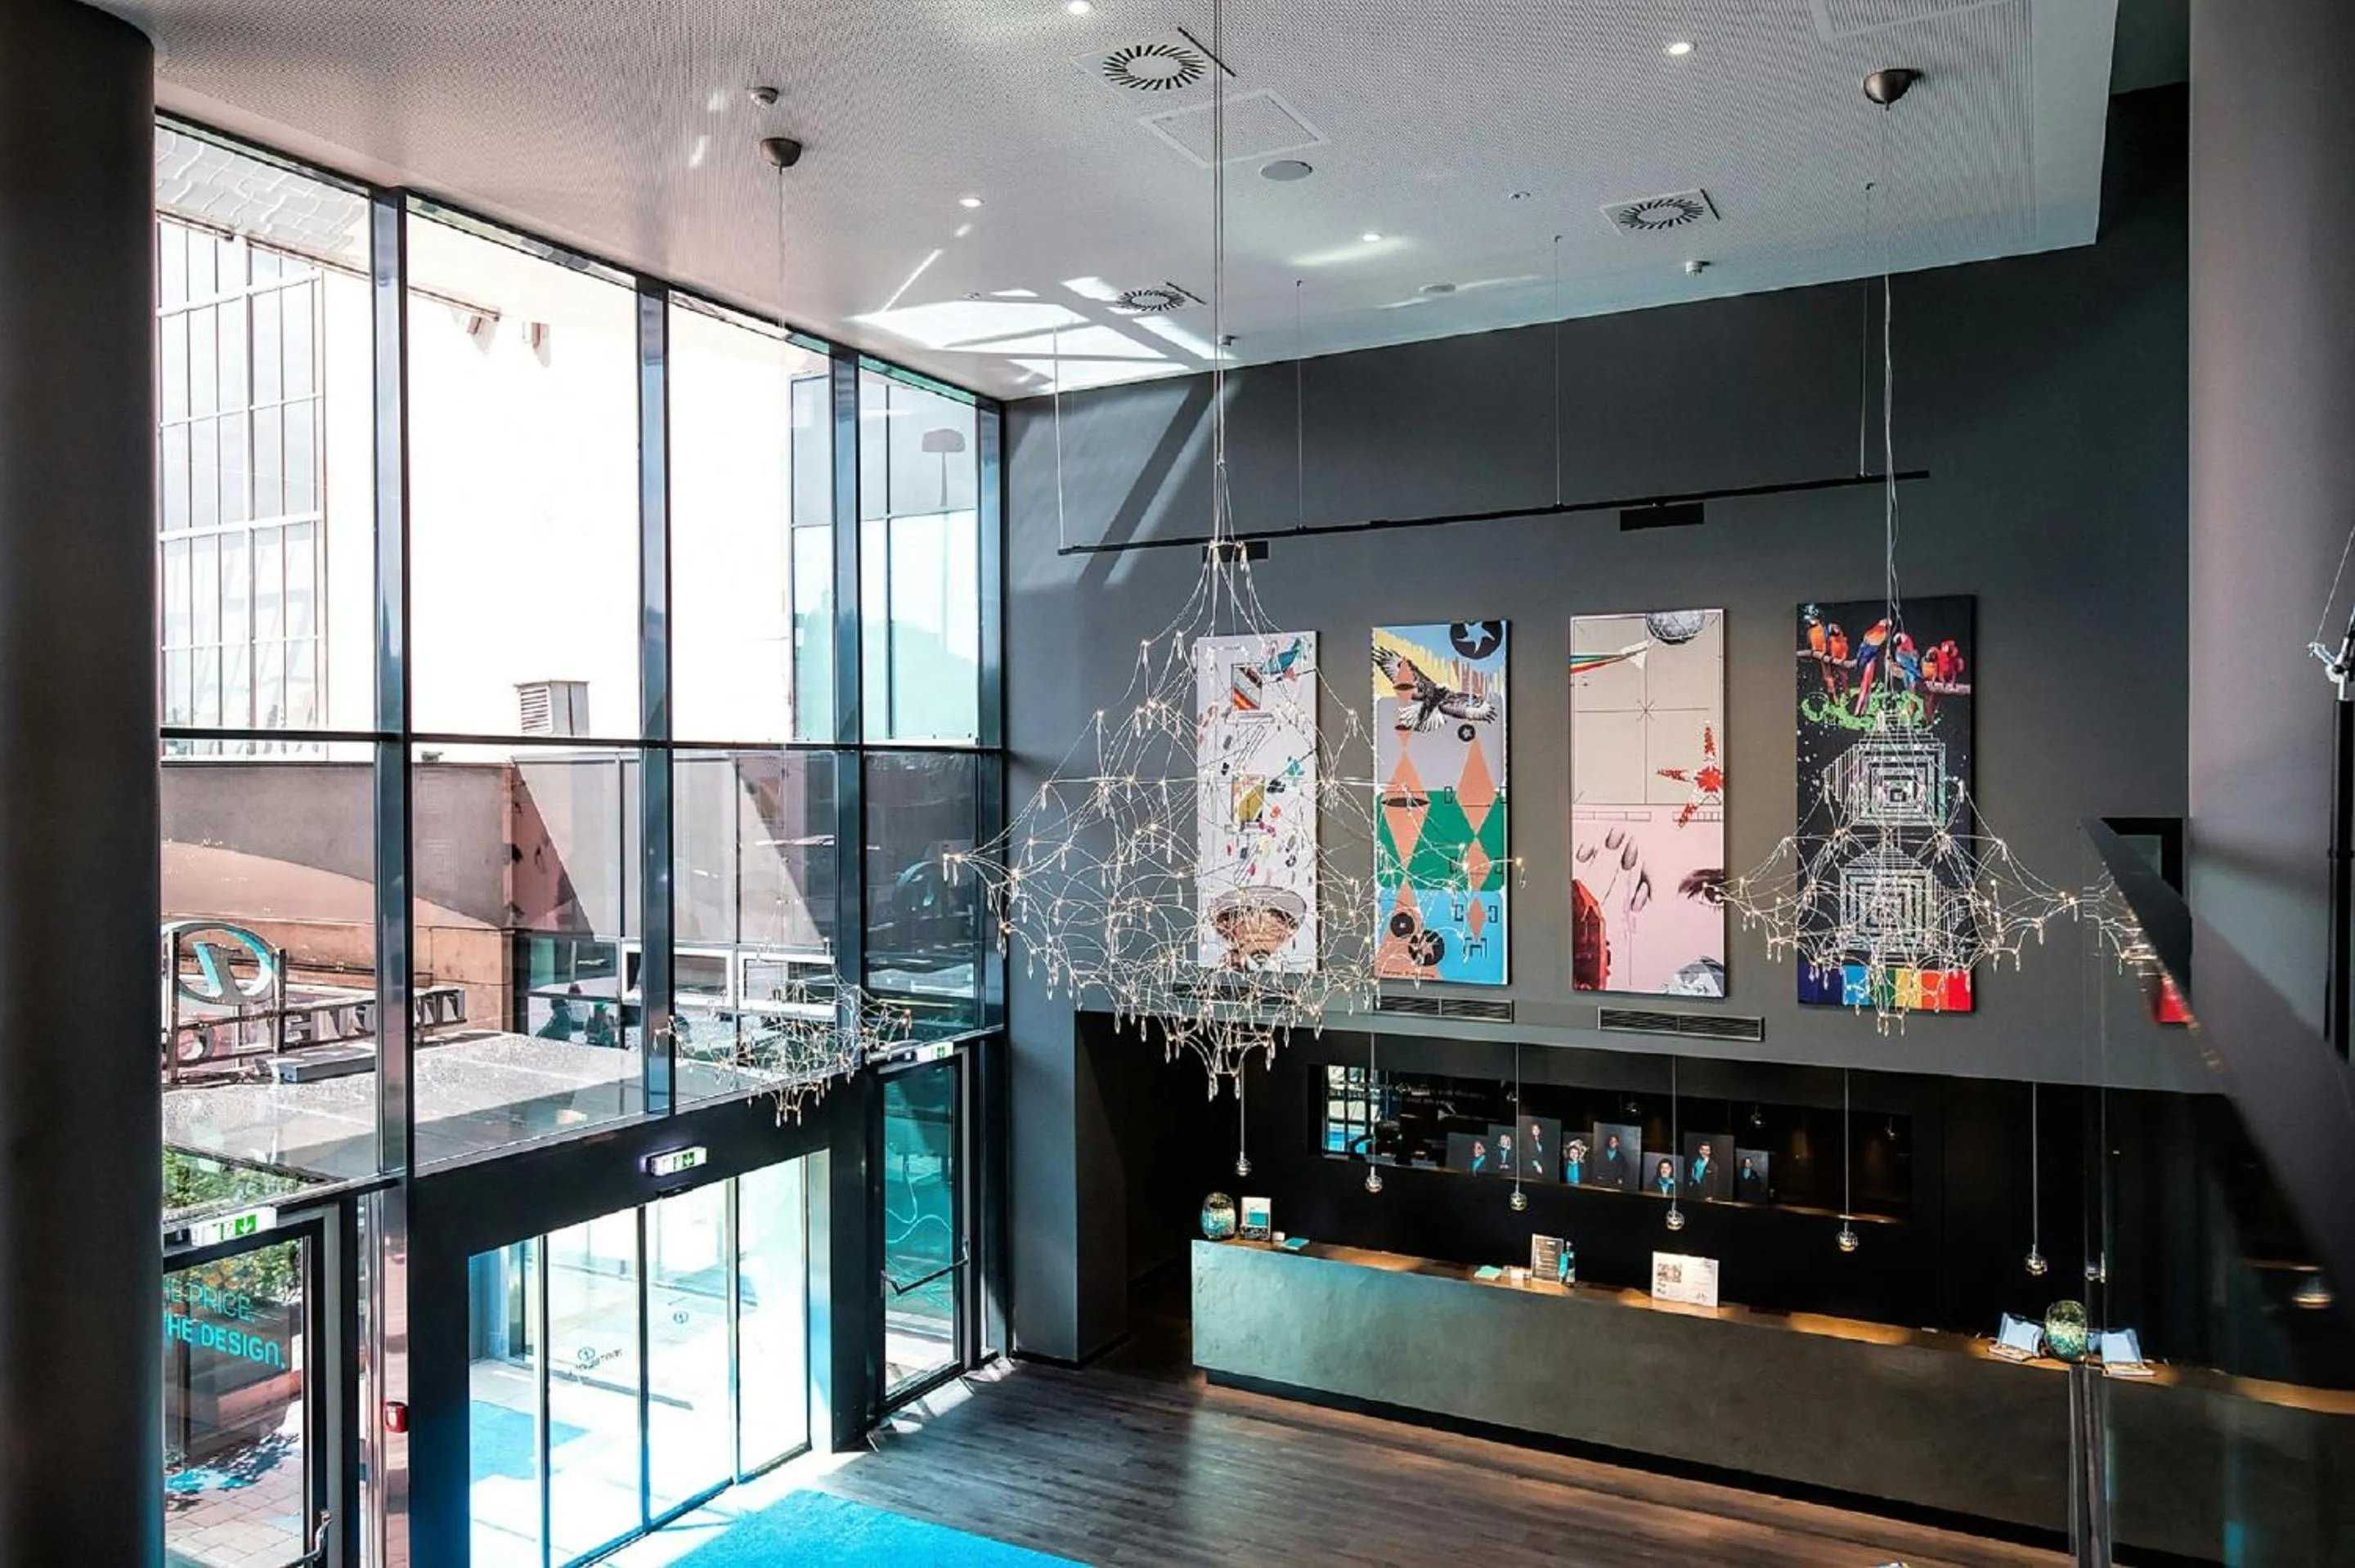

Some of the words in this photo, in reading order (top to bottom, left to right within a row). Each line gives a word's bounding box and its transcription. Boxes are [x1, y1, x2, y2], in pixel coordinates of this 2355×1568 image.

[163, 1277, 182, 1302] HE
[186, 1282, 255, 1324] PRICE.
[163, 1311, 194, 1343] HE
